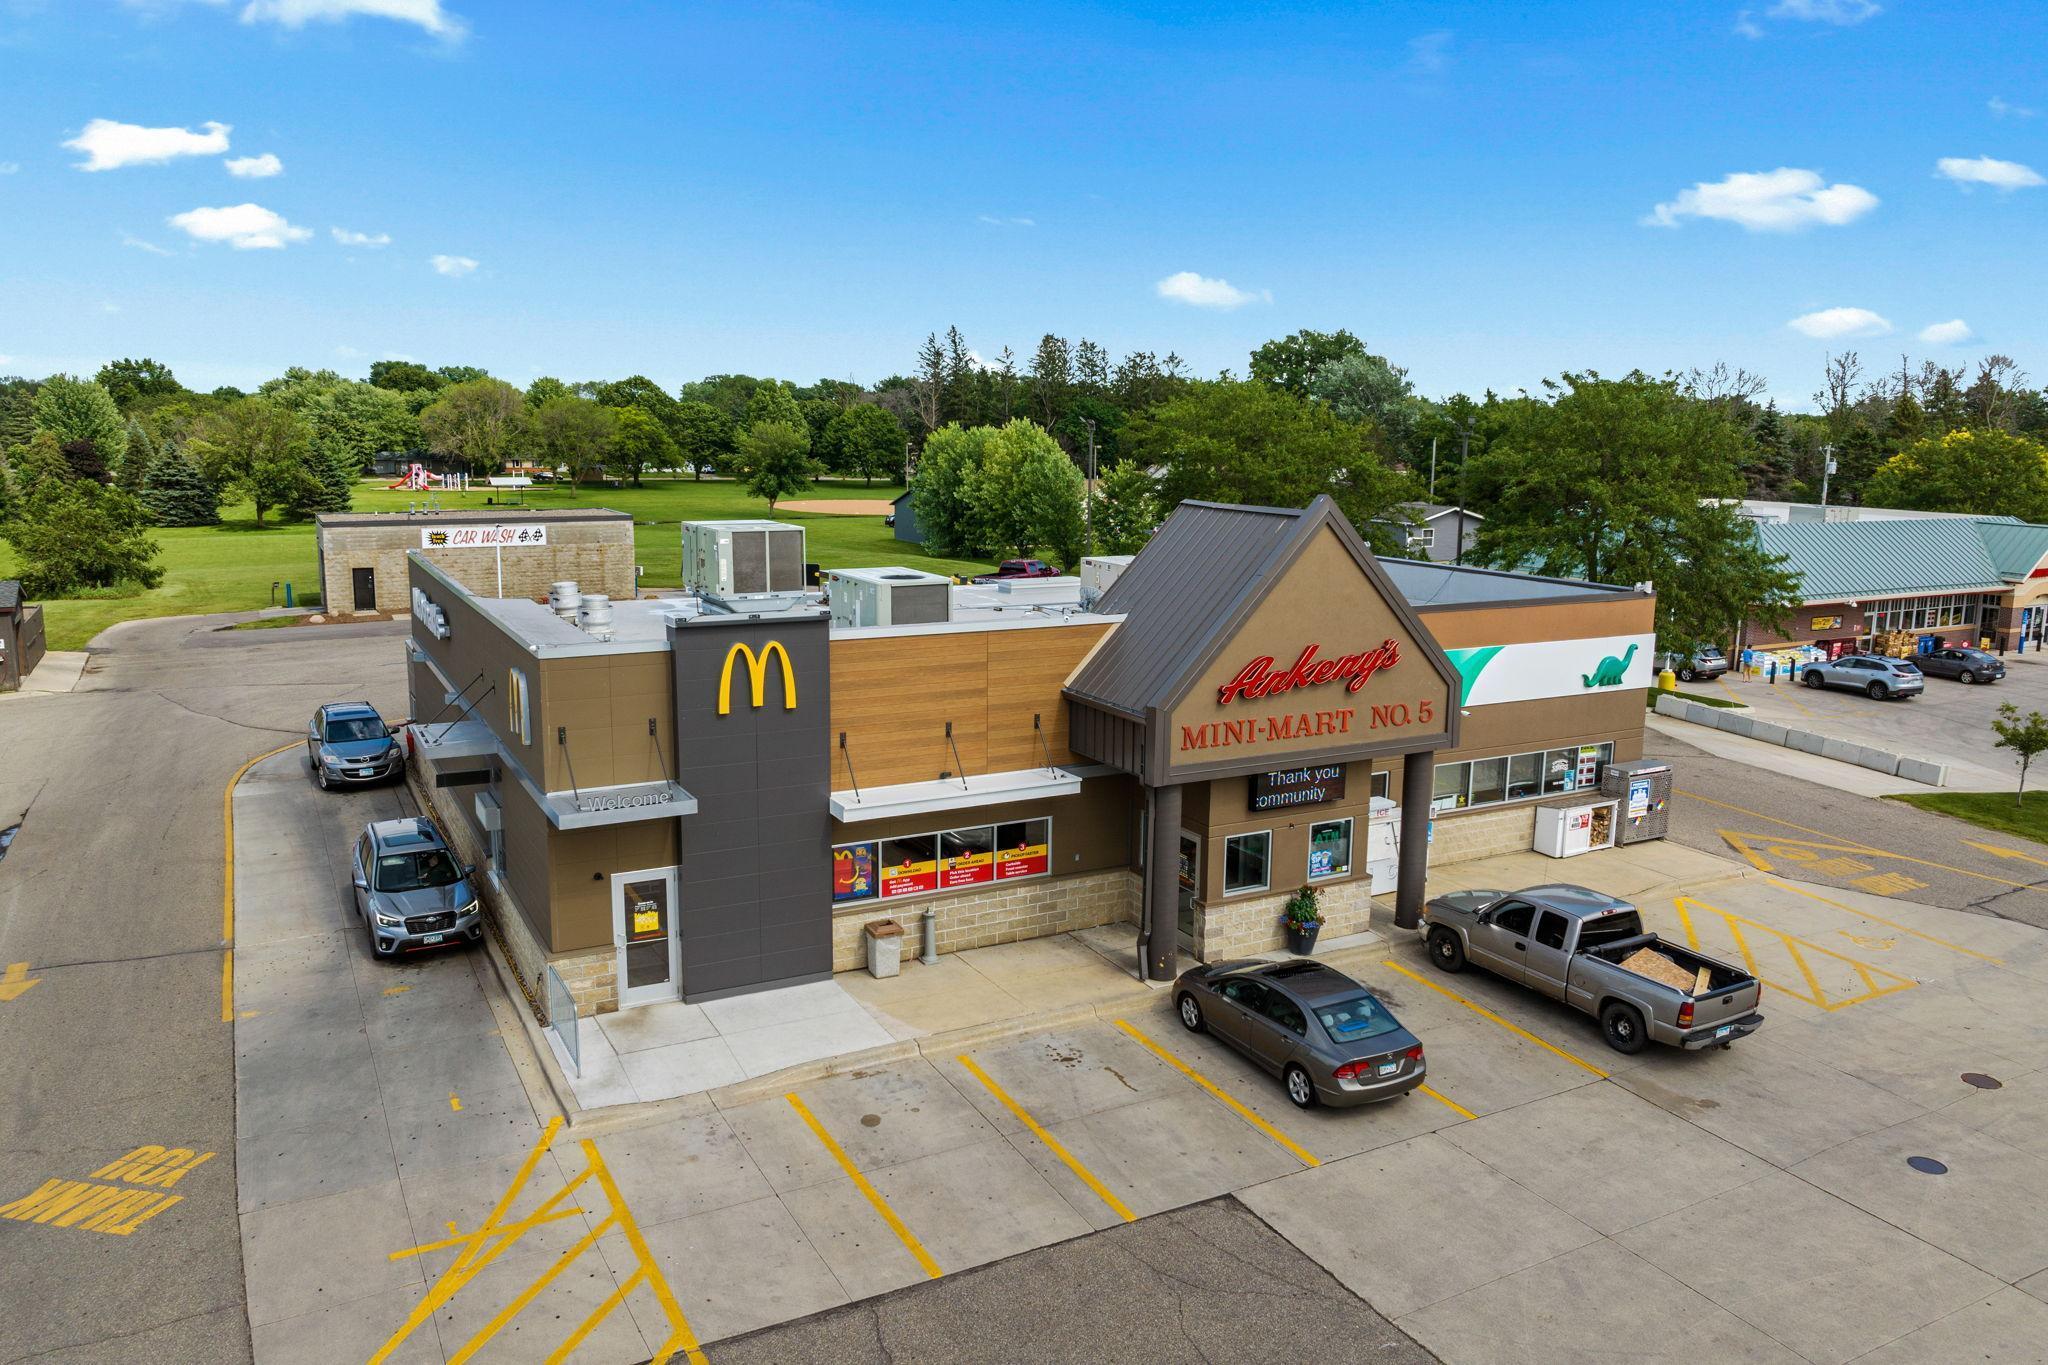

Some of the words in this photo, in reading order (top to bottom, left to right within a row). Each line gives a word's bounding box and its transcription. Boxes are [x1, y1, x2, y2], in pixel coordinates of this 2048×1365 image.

[453, 530, 477, 544] CAR
[1217, 639, 1401, 704] Ankeny's
[1181, 708, 1354, 750] MINI-MART
[1370, 703, 1411, 729] NO.
[1419, 700, 1434, 723] 5
[1268, 767, 1311, 786] Thank
[1315, 765, 1340, 784] you
[588, 792, 669, 811] Welcome
[1376, 808, 1390, 816] ICE
[1315, 831, 1340, 844] ATM
[89, 1145, 217, 1187] YOU
[0, 1178, 184, 1235] THANK
